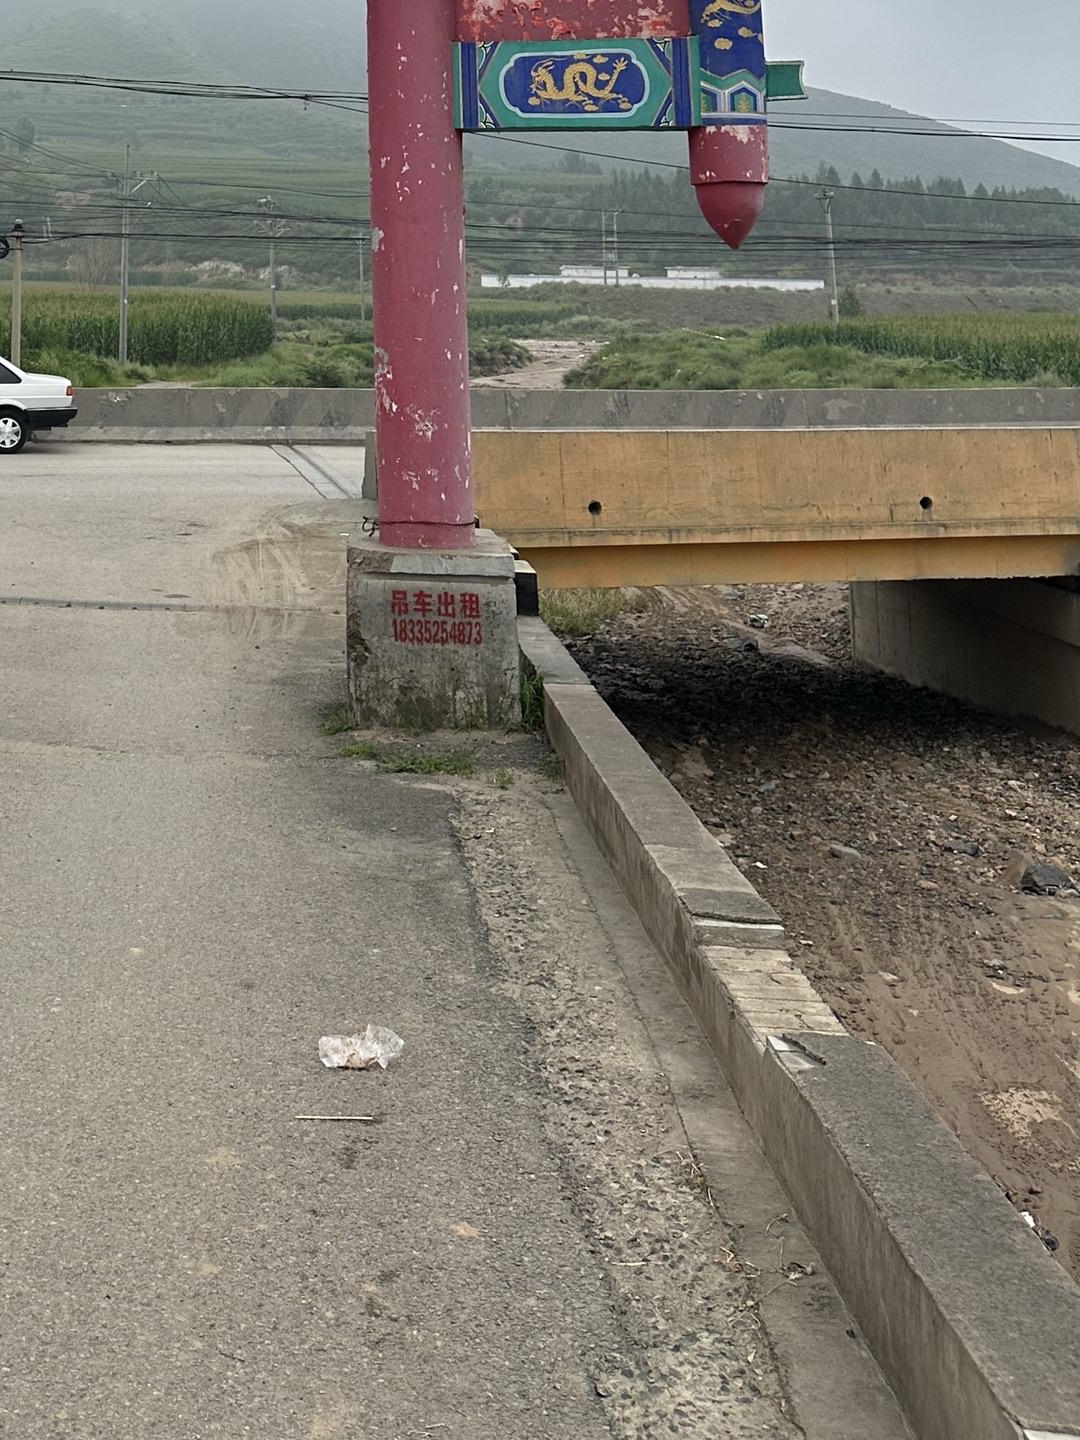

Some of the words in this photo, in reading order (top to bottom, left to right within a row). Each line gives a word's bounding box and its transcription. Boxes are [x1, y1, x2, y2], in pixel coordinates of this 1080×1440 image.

[391, 590, 482, 618] 吊车出租
[391, 619, 482, 645] 18335254873
